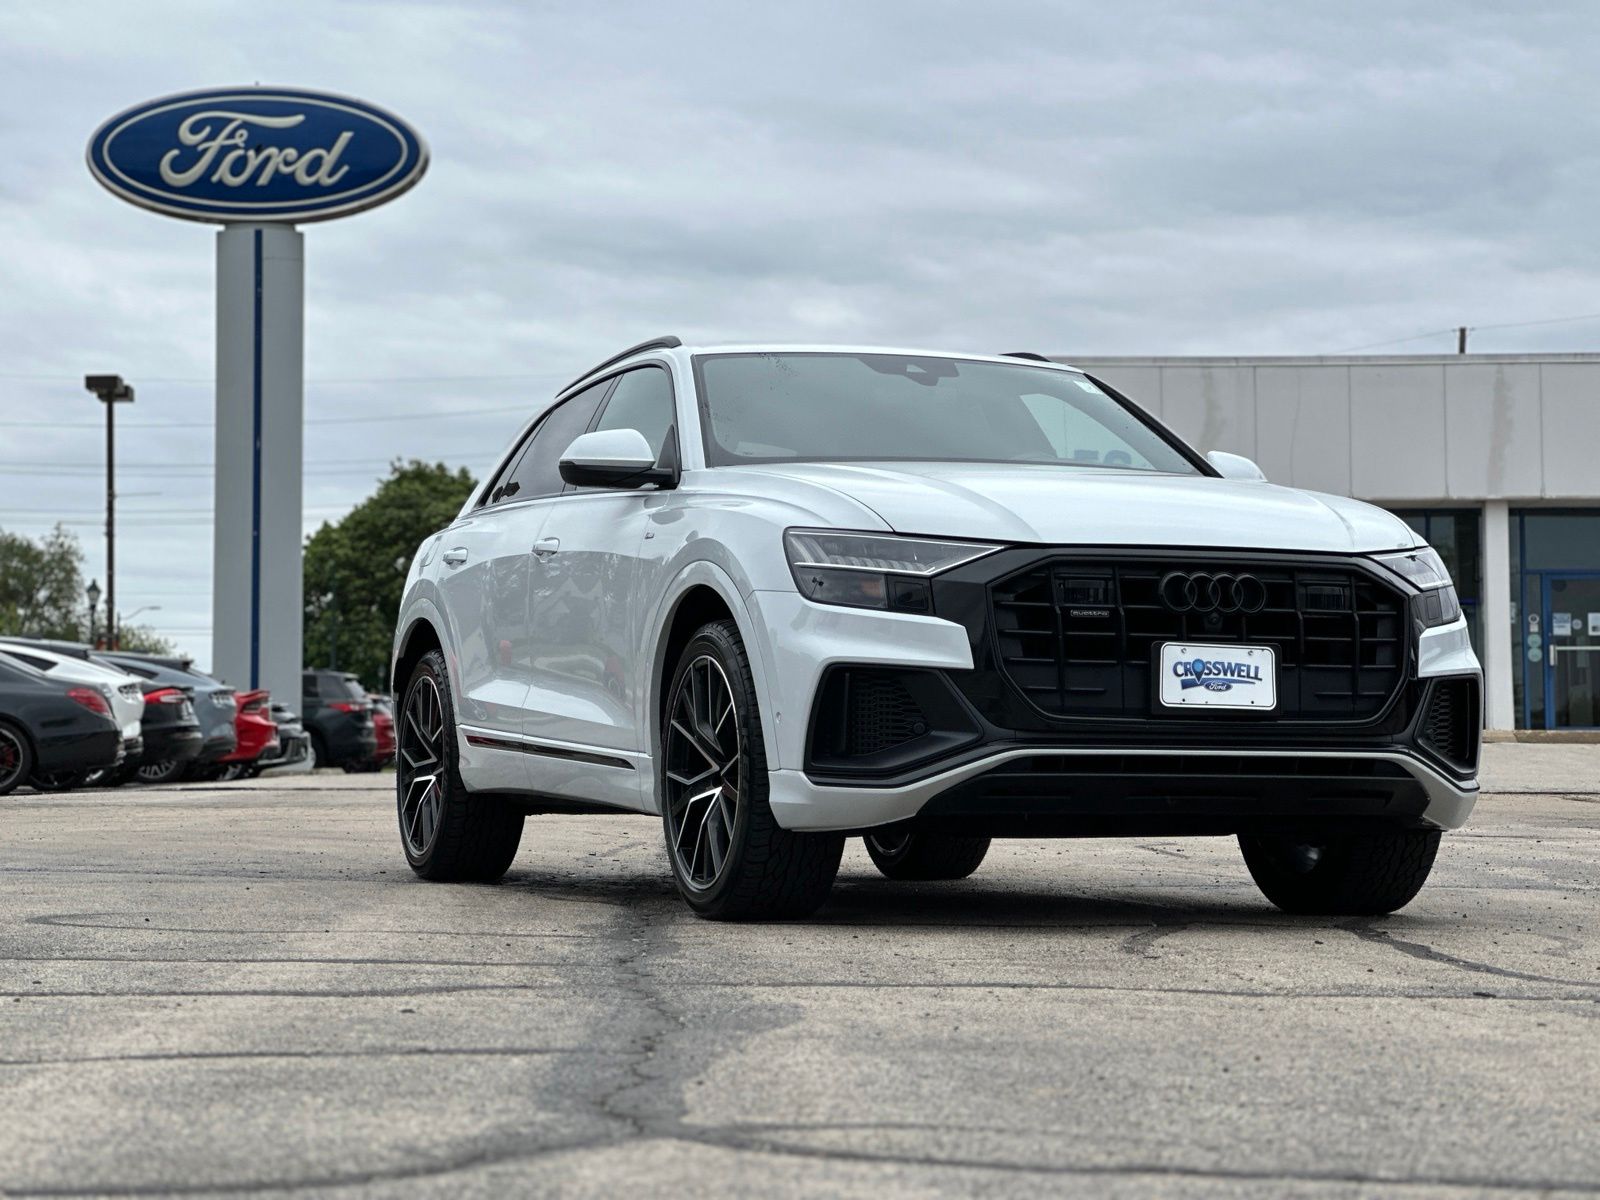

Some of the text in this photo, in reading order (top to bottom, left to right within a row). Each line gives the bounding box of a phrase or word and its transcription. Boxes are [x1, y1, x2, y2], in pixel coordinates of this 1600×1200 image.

[159, 110, 354, 187] Ford
[1173, 659, 1262, 681] CROSSWELL
[1209, 681, 1227, 690] Ford
